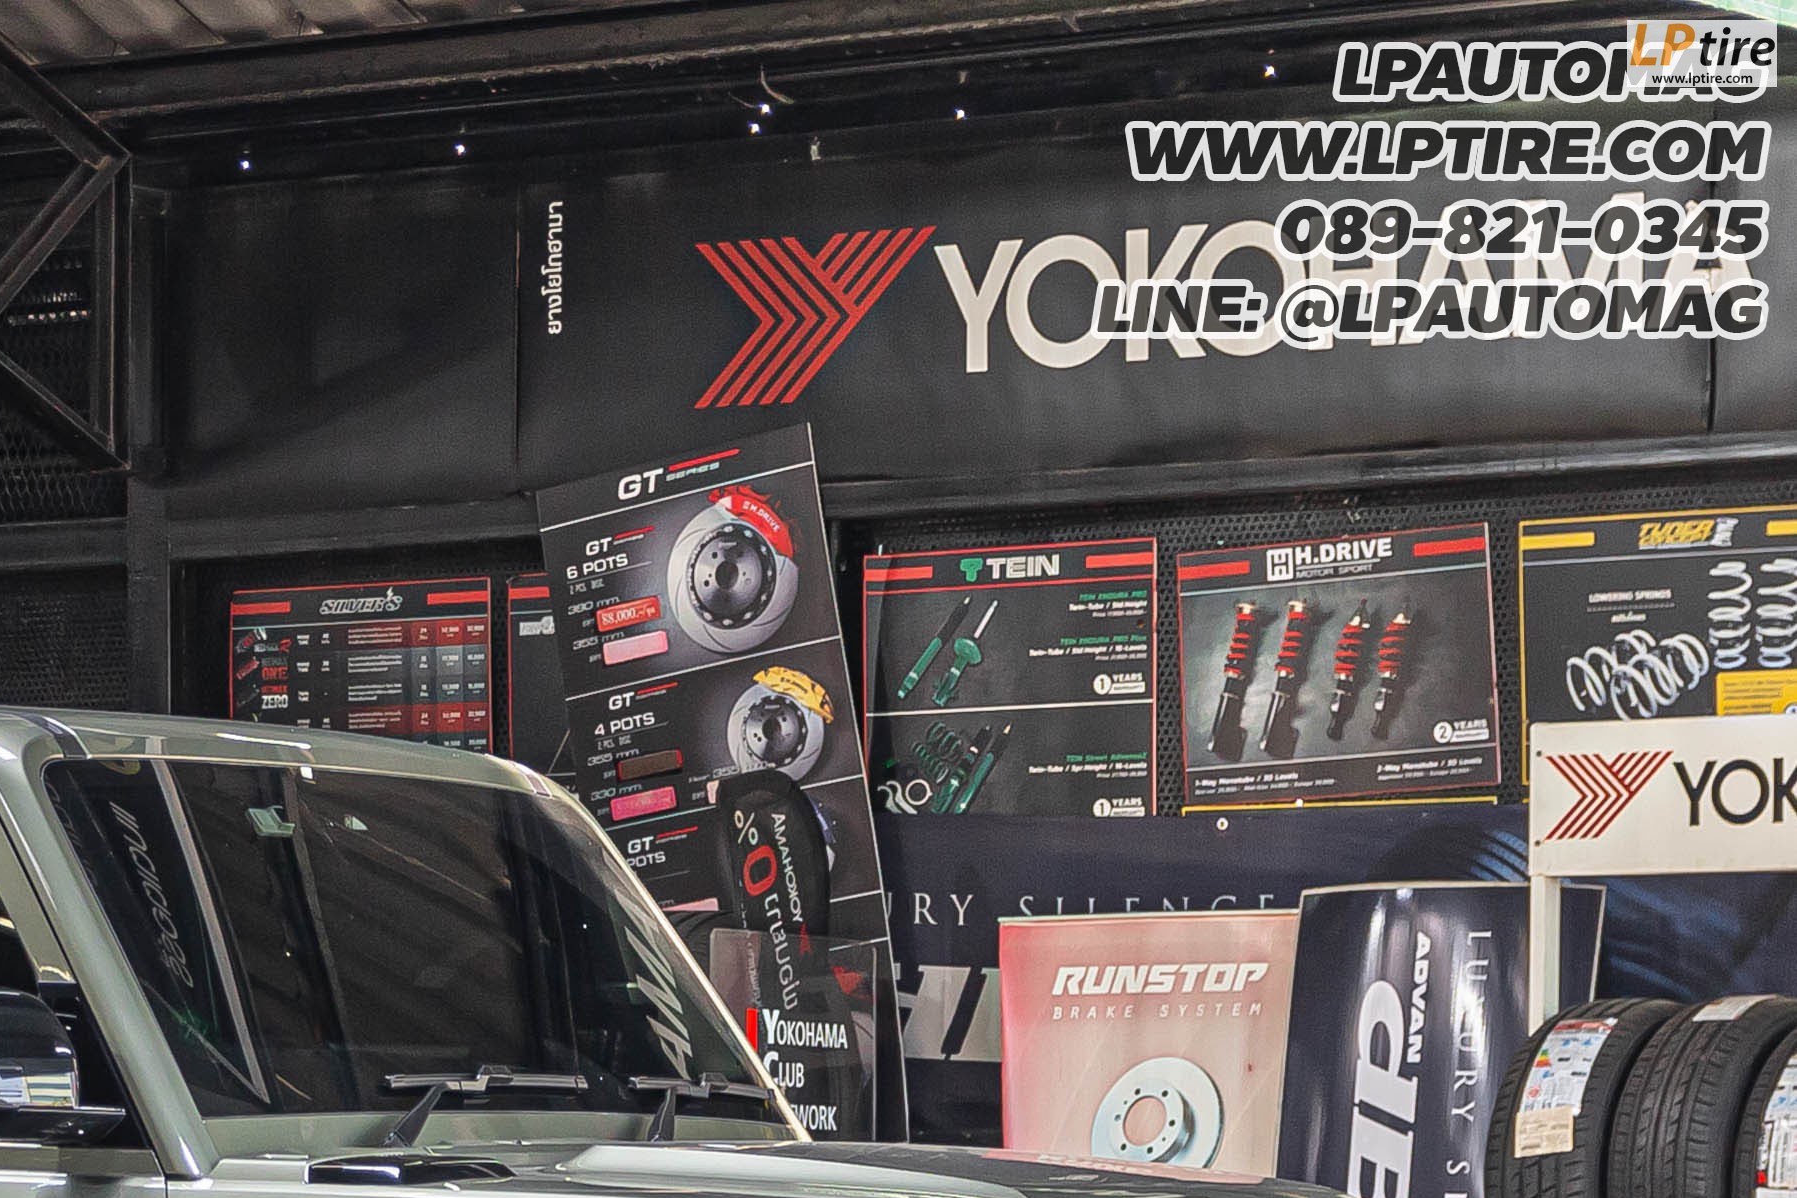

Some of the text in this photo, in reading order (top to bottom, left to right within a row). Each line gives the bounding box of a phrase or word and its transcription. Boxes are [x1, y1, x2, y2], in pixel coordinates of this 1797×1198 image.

[541, 201, 563, 335] ยางโยโกฮามา
[618, 467, 664, 500] GT
[585, 536, 613, 556] GT
[1294, 537, 1394, 566] H.DRIVE
[566, 553, 629, 580] 6 POTS
[985, 553, 1060, 580] TEIN
[261, 695, 289, 709] ZERO
[608, 691, 635, 711] GT
[594, 711, 656, 736] 4 POTS
[627, 835, 655, 855] GT
[886, 893, 974, 927] RY
[1051, 962, 1270, 996] RUNSTOP
[1052, 1001, 1263, 1020] BRAKE SYSTEM
[1406, 931, 1432, 1065] ADVAN
[762, 1008, 849, 1049] YOKOHAMA
[1452, 930, 1493, 1123] LUURY
[763, 1051, 805, 1088] CLUB
